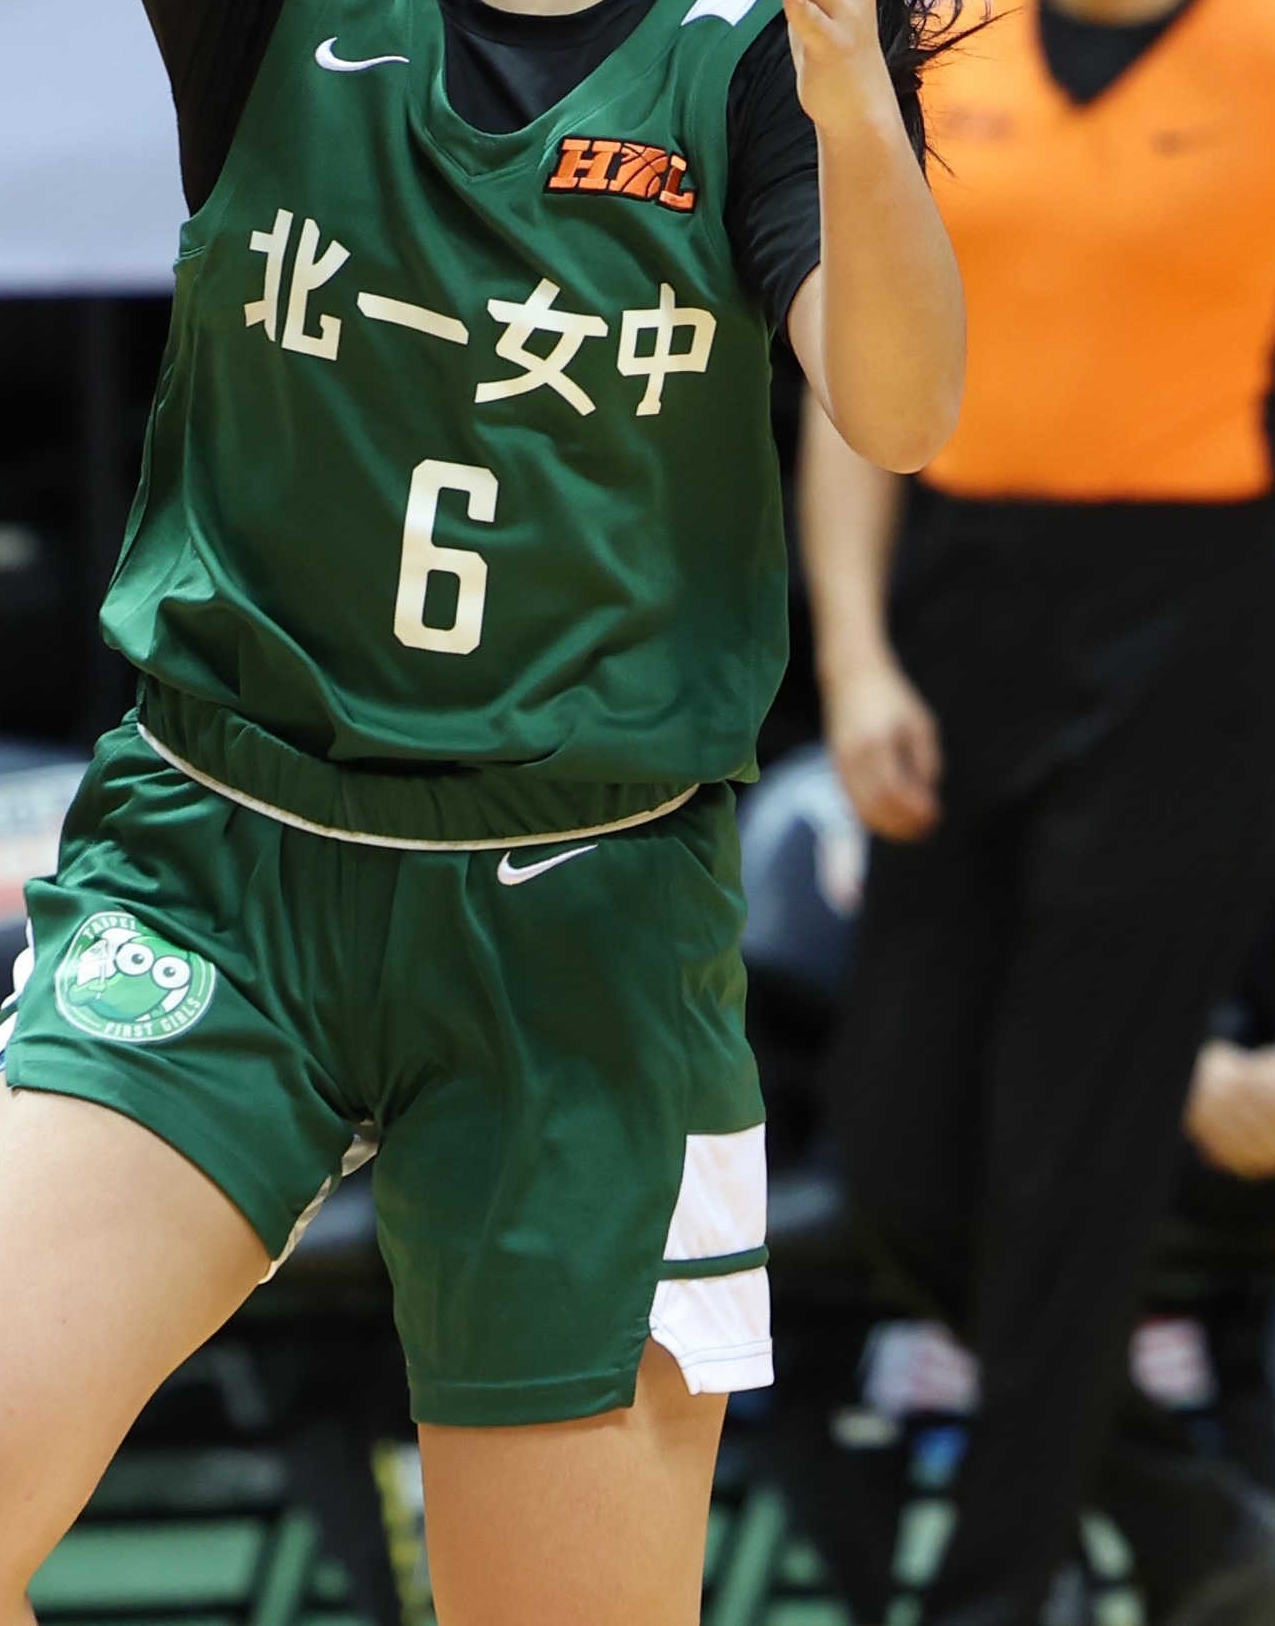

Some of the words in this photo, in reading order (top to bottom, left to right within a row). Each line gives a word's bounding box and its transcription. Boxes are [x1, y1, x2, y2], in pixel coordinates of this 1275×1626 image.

[243, 207, 717, 416] 北一女中
[393, 458, 499, 656] 6
[83, 916, 137, 940] TAIPEI
[103, 1022, 154, 1038] FIRST
[161, 997, 201, 1033] GIRLS
